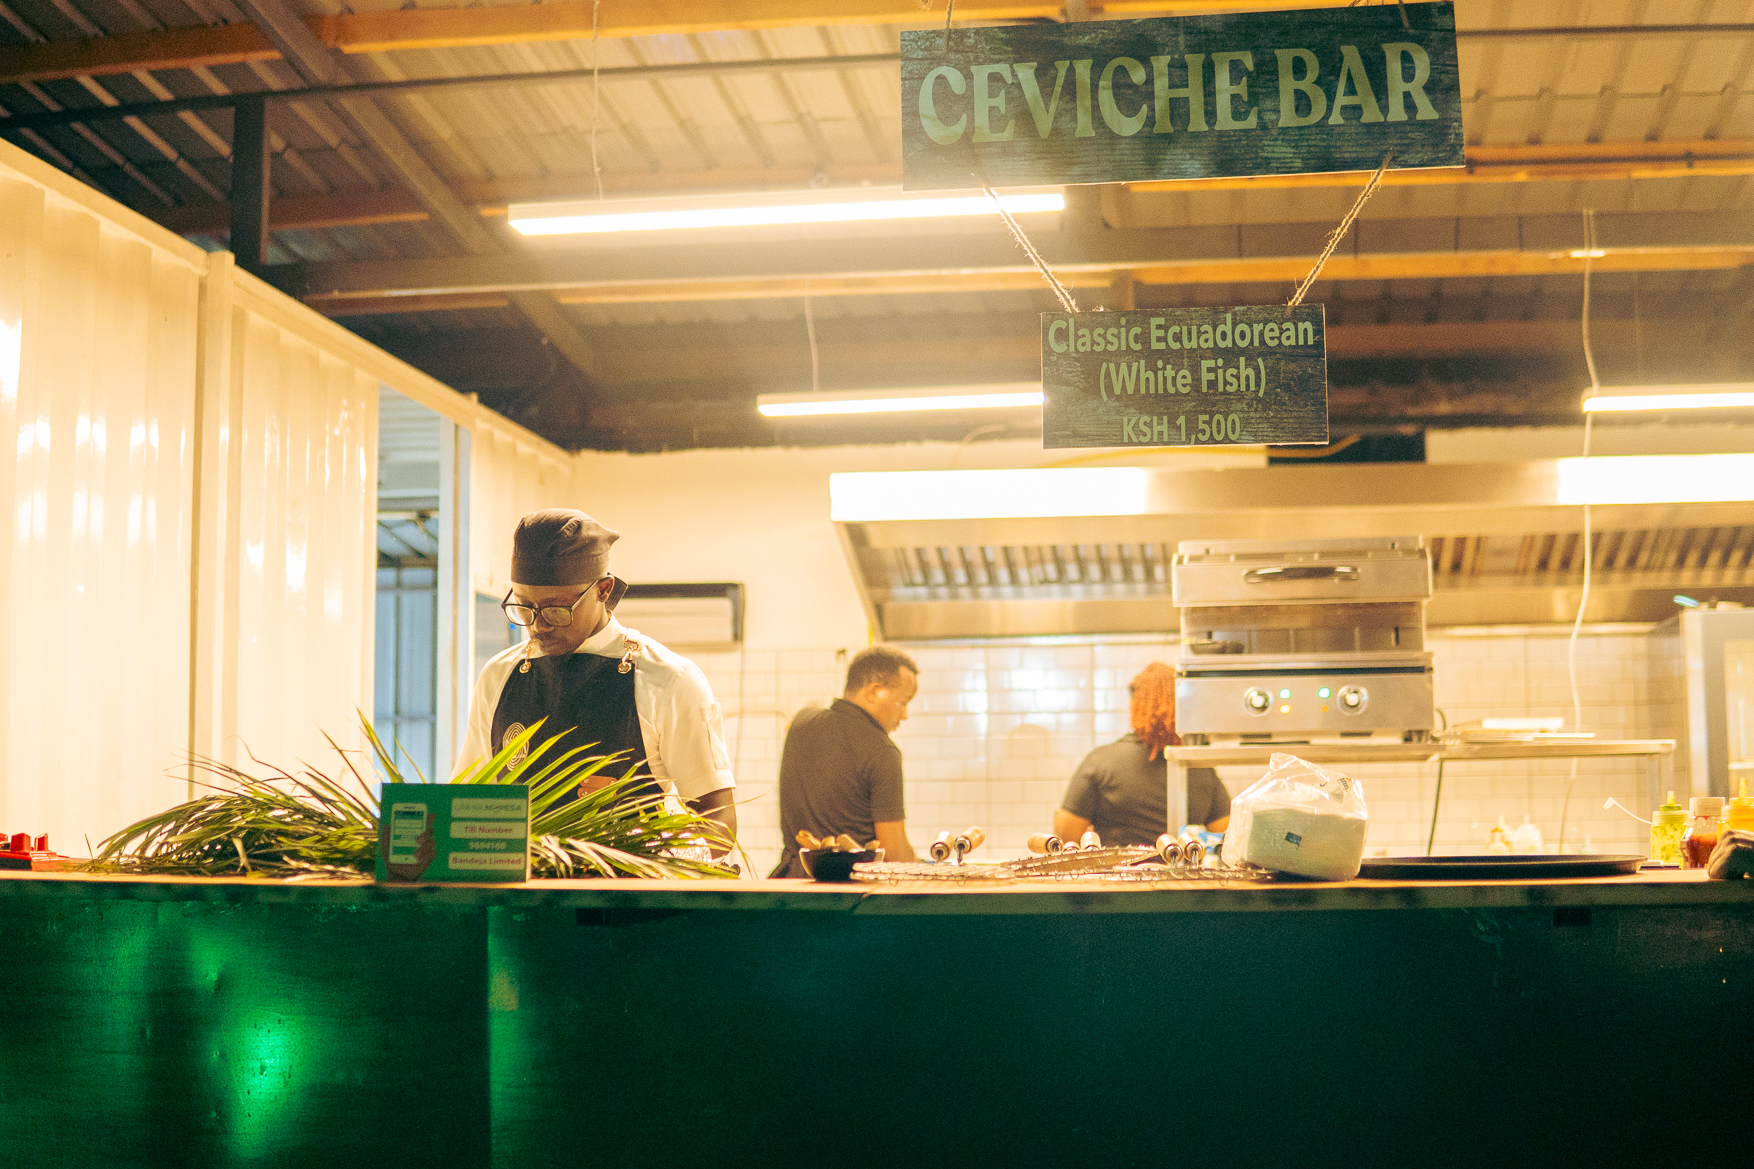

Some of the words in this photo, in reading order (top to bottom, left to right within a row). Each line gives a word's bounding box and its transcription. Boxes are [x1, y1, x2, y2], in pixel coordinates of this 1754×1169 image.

[919, 49, 1259, 145] CEVICHE
[1276, 42, 1440, 128] BAR
[1049, 317, 1142, 353] Classic
[1150, 313, 1314, 350] Ecuadorean
[1100, 360, 1192, 400] (White
[1201, 357, 1266, 397] Fish)
[1123, 415, 1169, 443] KSH
[1175, 413, 1241, 445] 1,500
[479, 826, 512, 834] Number
